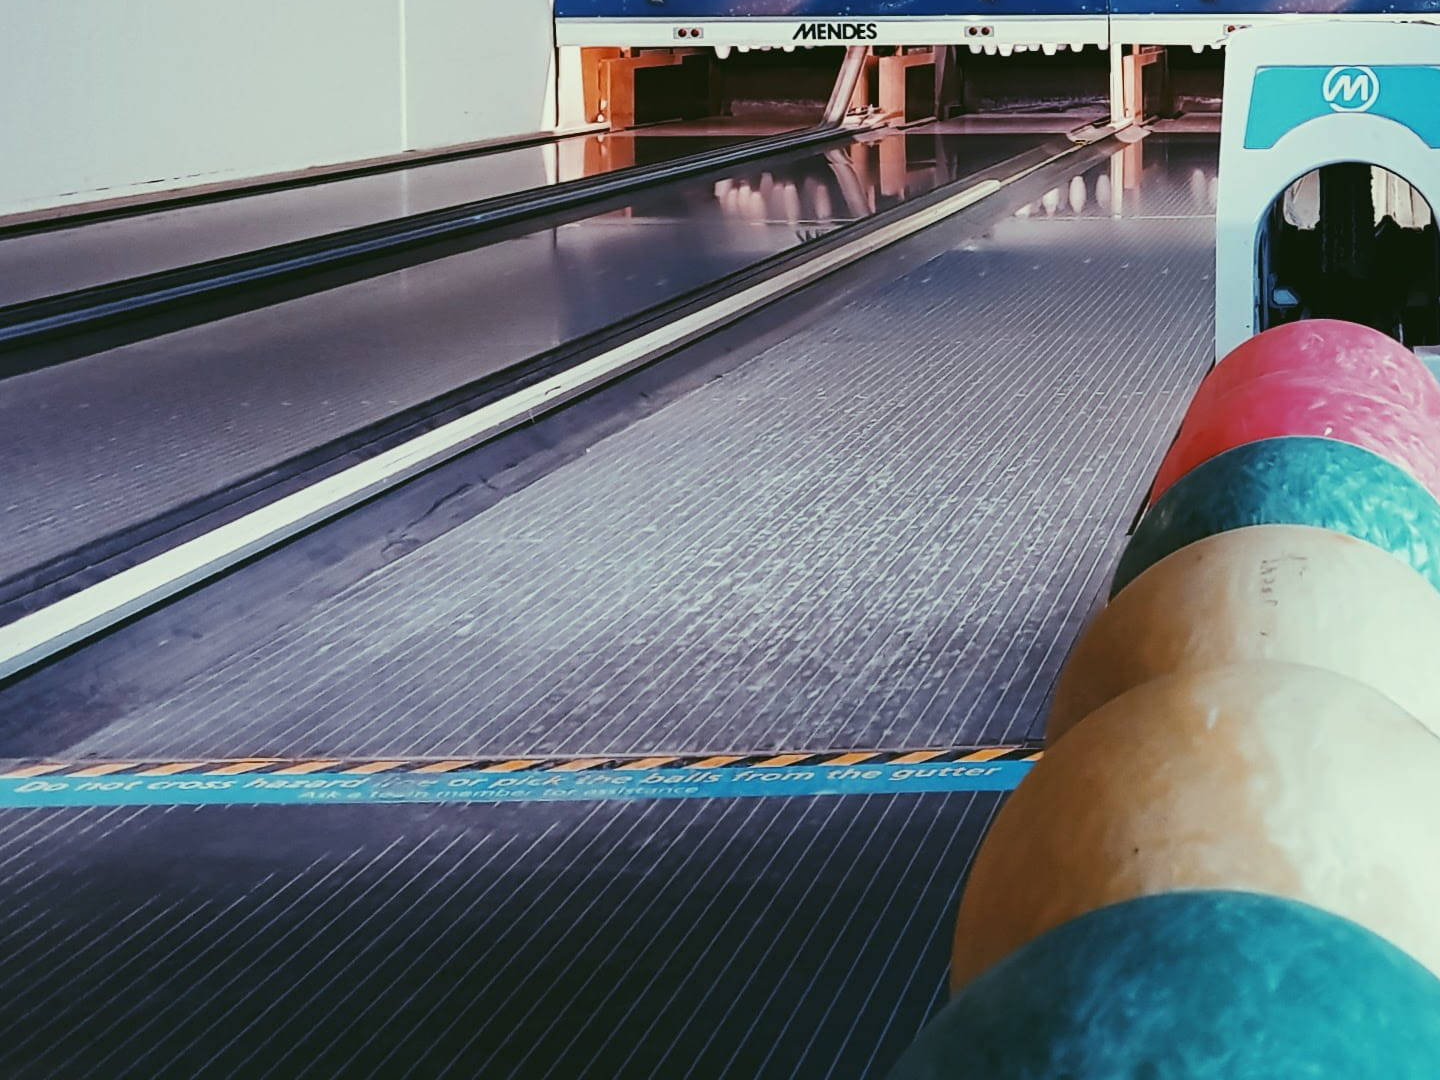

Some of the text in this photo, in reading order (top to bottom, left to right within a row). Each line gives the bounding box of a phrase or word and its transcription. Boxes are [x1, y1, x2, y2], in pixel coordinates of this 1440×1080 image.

[792, 23, 878, 41] MENDES
[14, 780, 70, 793] Do
[74, 780, 144, 792] not
[147, 779, 237, 790] cross
[242, 777, 371, 790] hazard
[448, 777, 489, 788] or
[488, 773, 567, 789] pick
[575, 773, 633, 786] the
[640, 771, 724, 785] balls
[731, 770, 816, 783] from
[826, 768, 883, 780] the
[888, 766, 1002, 781] gutter
